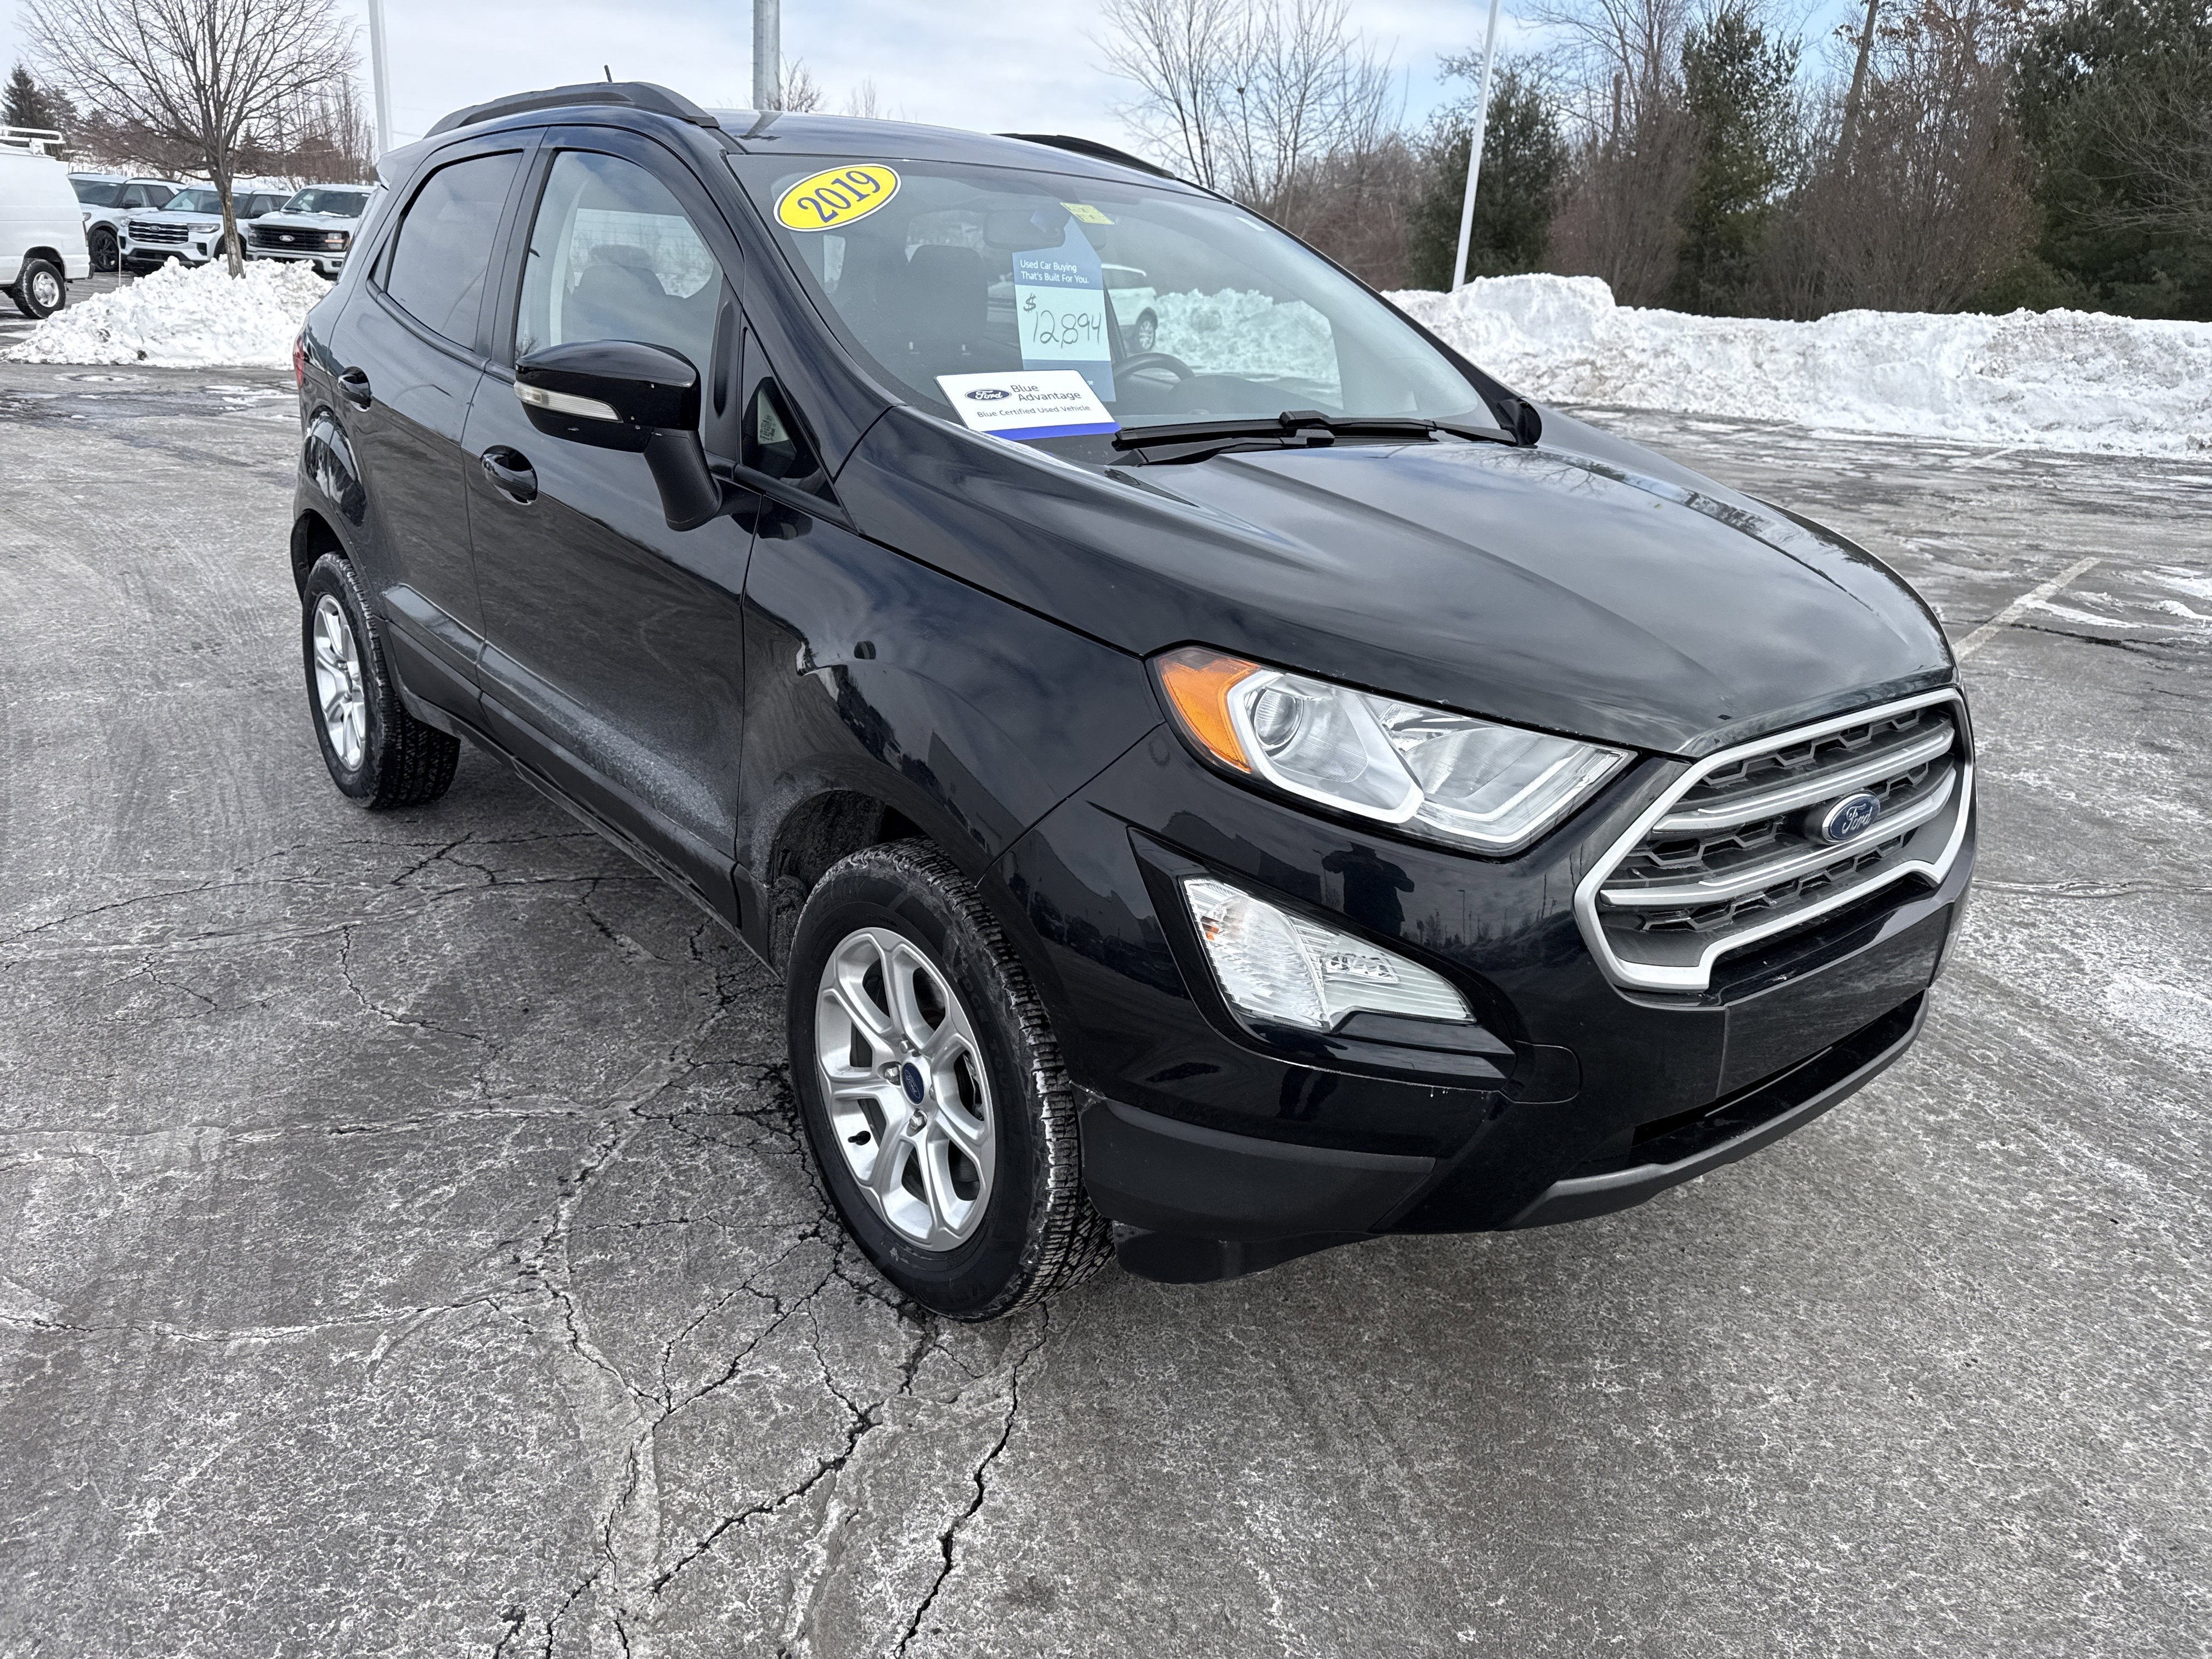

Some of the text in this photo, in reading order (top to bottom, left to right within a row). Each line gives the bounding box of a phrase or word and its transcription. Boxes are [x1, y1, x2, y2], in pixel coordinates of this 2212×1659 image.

[797, 171, 881, 223] 2019
[1020, 259, 1077, 273] Used Car Buying
[1021, 271, 1090, 284] That's Built For You.
[1010, 384, 1039, 393] Blue
[1018, 392, 1082, 402] Advantage
[999, 408, 1036, 416] Certified
[1842, 803, 1873, 834] Ford
